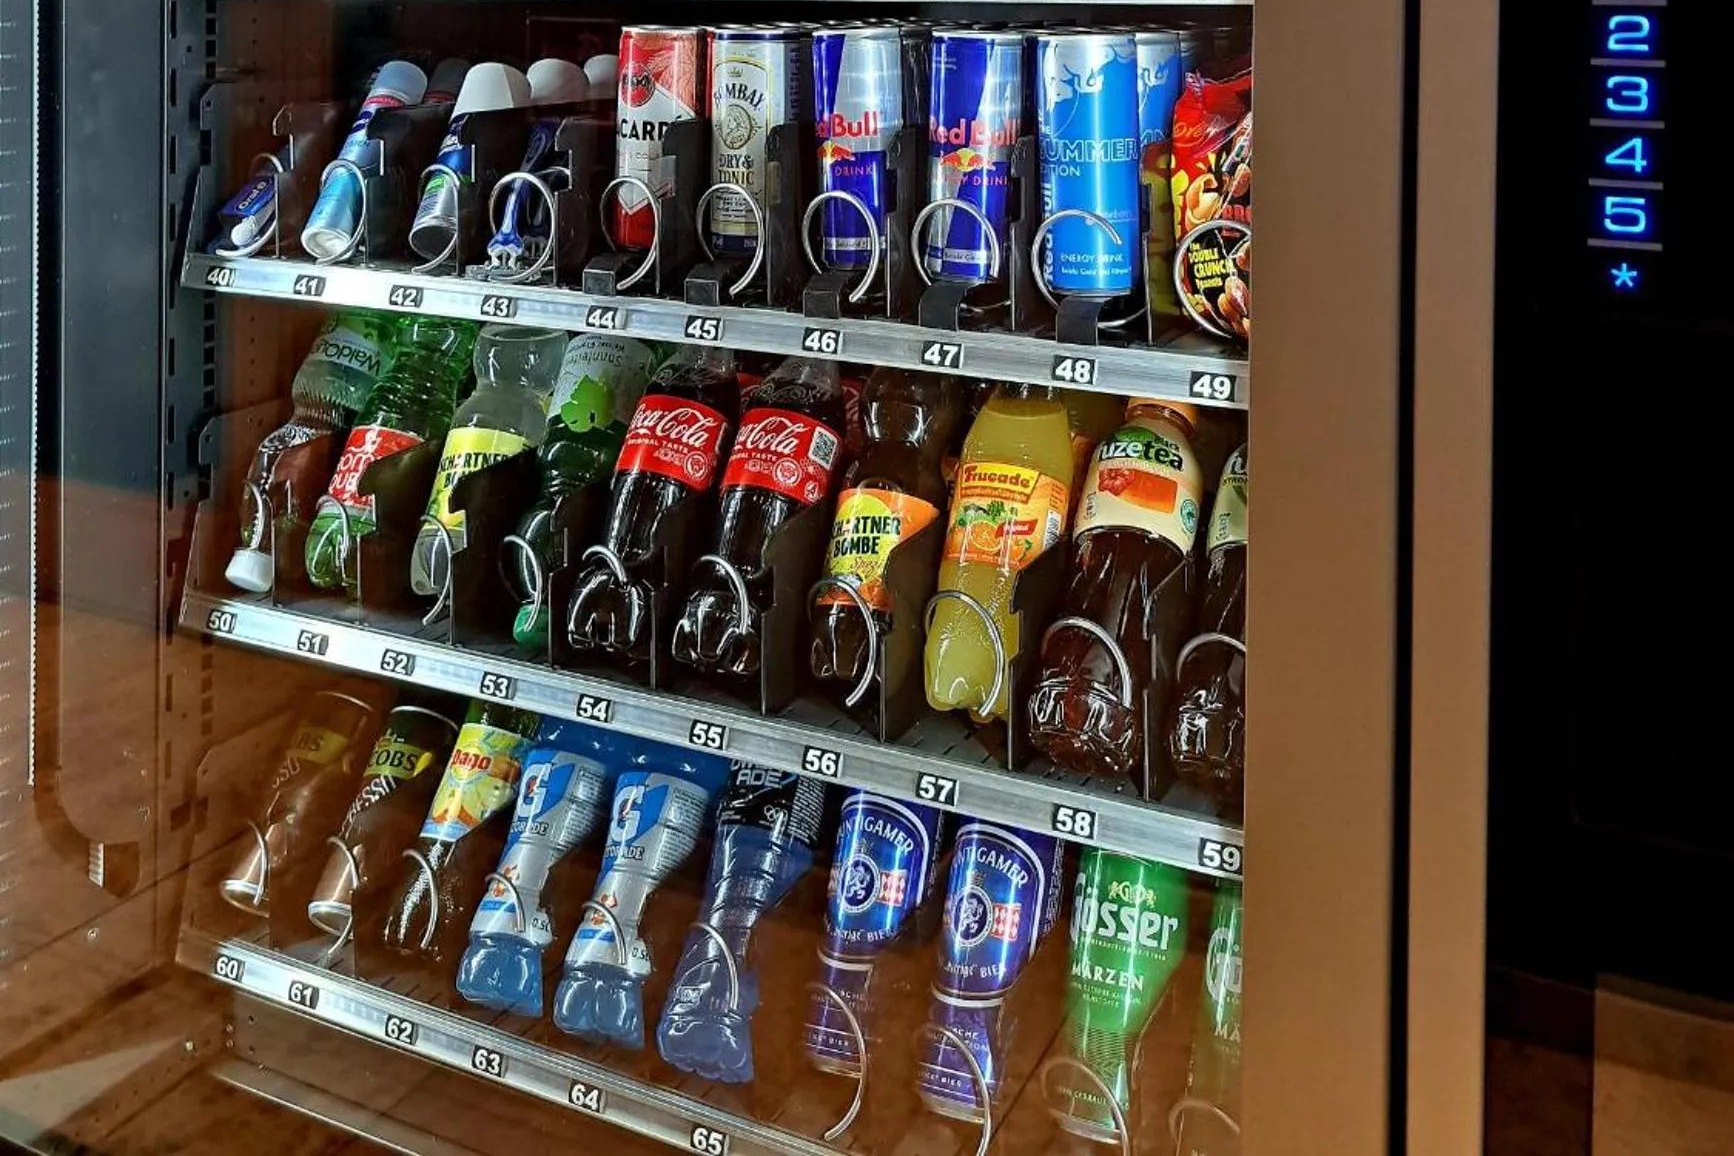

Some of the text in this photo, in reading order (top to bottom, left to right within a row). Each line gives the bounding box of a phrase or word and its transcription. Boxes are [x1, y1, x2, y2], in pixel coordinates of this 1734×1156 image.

[1607, 15, 1650, 51] 2
[1607, 76, 1648, 111] 3
[831, 111, 878, 138] Bull
[929, 116, 966, 144] Red
[1605, 138, 1647, 172] 4
[835, 165, 873, 177] DRINK
[1604, 197, 1646, 233] 5
[207, 269, 229, 285] 40
[296, 279, 317, 295] 41
[391, 289, 416, 306] 42
[483, 299, 508, 316] 43
[589, 310, 614, 328] 44
[688, 321, 717, 339] 45
[806, 332, 836, 353] 46
[924, 346, 958, 365] 47
[1056, 360, 1090, 384] 48
[1193, 376, 1232, 400] 49
[964, 465, 1031, 489] Frucade
[833, 536, 880, 558] BOMBE
[209, 613, 232, 631] 50
[299, 632, 322, 652] 51
[383, 652, 406, 673] 52
[482, 673, 508, 694] 53
[580, 701, 606, 721] 54
[692, 724, 721, 746] 55
[453, 748, 491, 771] pago
[805, 750, 836, 774] 56
[919, 775, 953, 801] 57
[1057, 810, 1091, 836] 58
[1203, 845, 1241, 871] 59
[217, 957, 238, 977] 60
[291, 984, 314, 1005] 61
[386, 1018, 412, 1041] 62
[474, 1049, 500, 1074] 63
[571, 1084, 600, 1110] 64
[693, 1128, 724, 1154] 65
